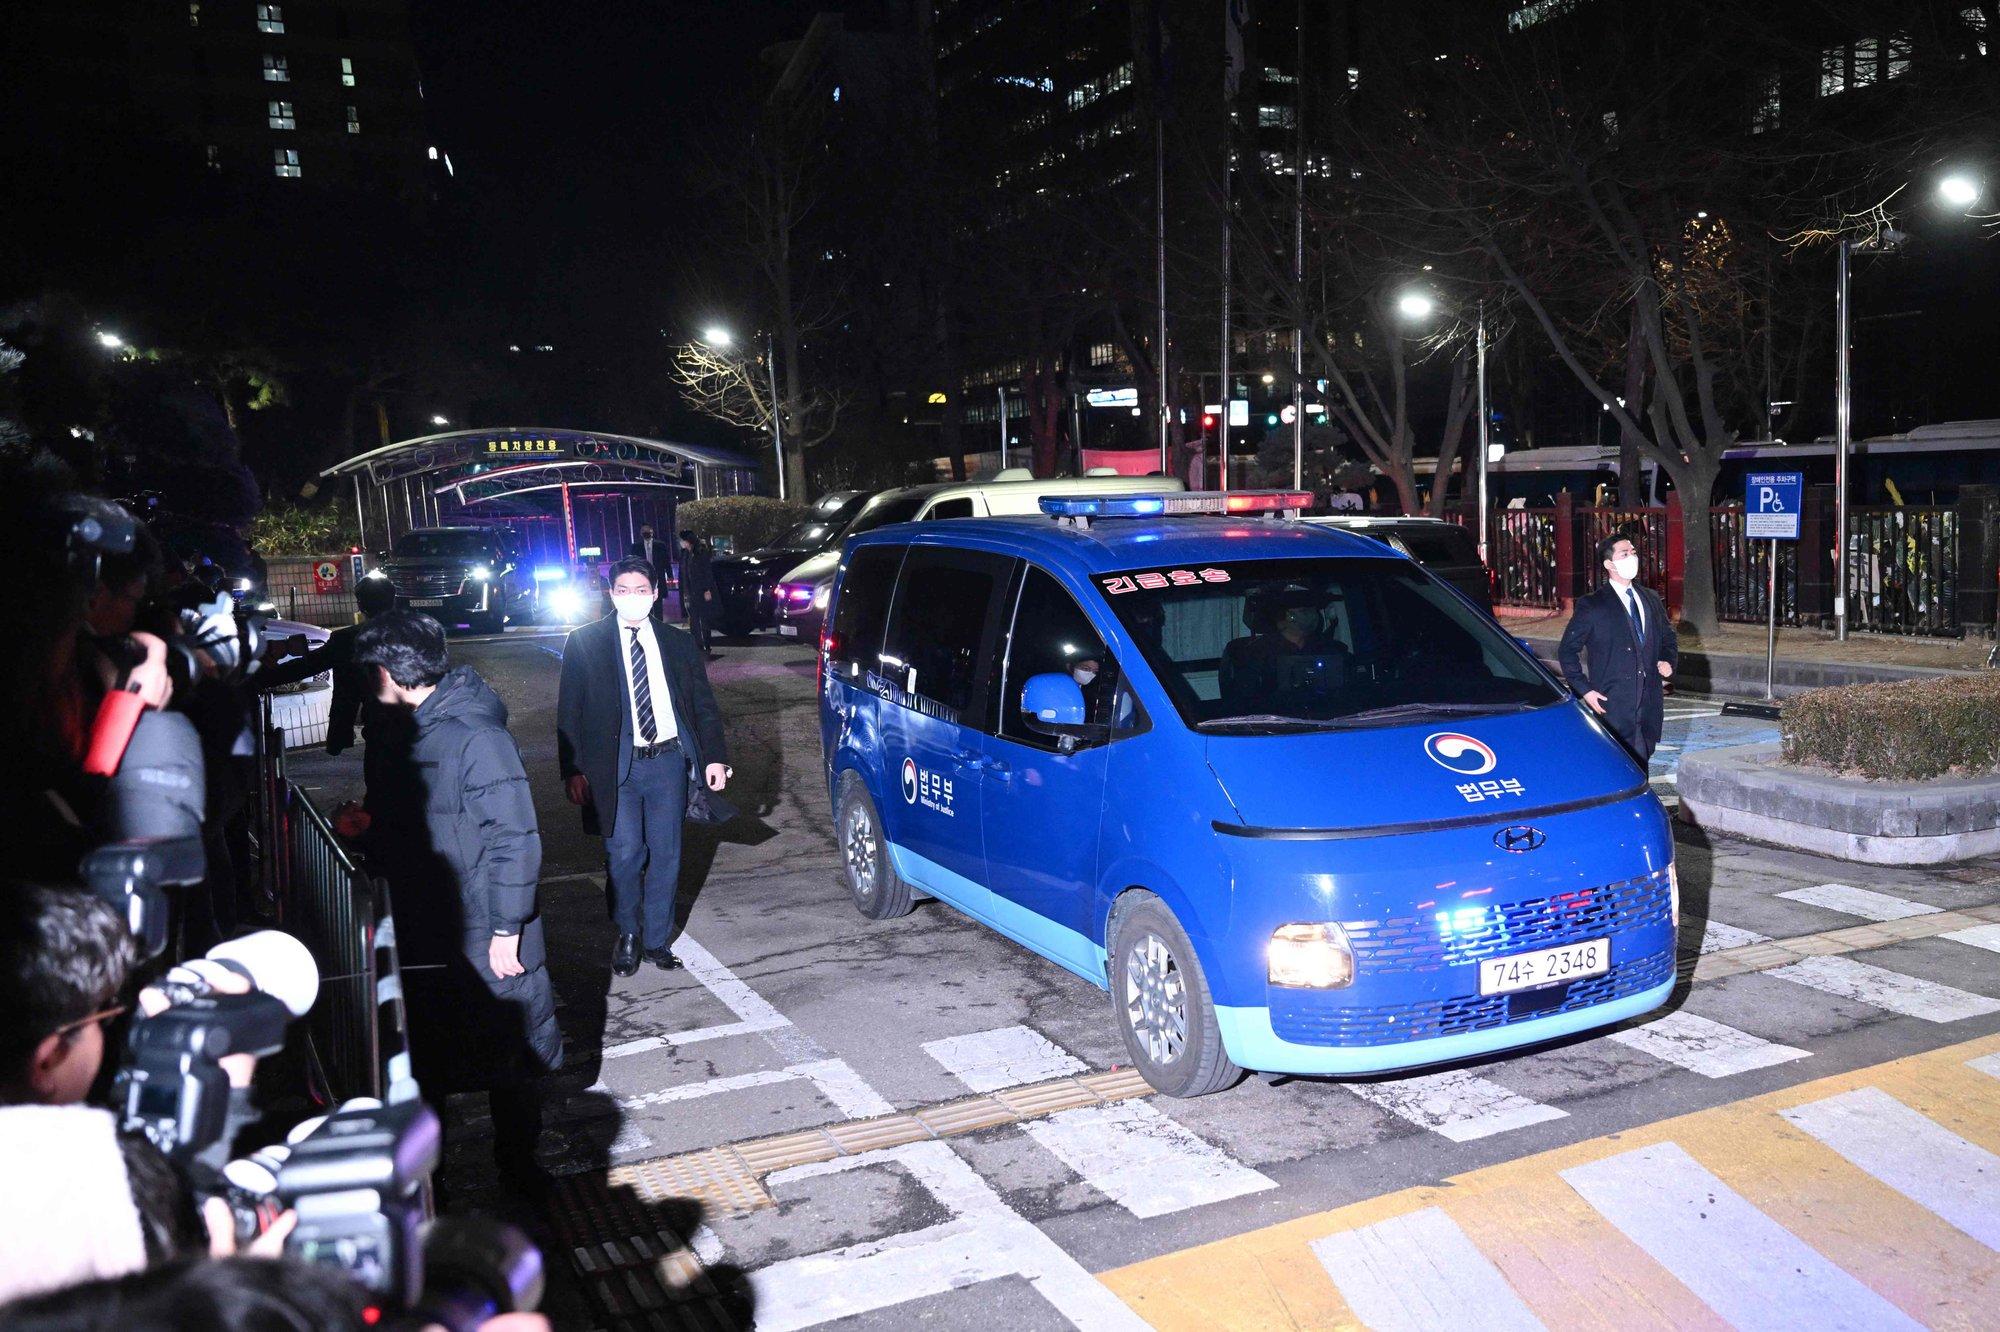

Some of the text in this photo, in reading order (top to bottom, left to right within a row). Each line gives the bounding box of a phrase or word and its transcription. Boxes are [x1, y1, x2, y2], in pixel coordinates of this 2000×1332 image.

[488, 440, 556, 452] 등록차량전용
[1751, 475, 1797, 484] 장애인전용 주차구역
[1760, 487, 1774, 512] P
[1102, 567, 1232, 595] 긴급호송
[920, 768, 954, 806] 법무부
[1454, 777, 1526, 803] 법무부
[1494, 946, 1597, 986] 74수 2348
